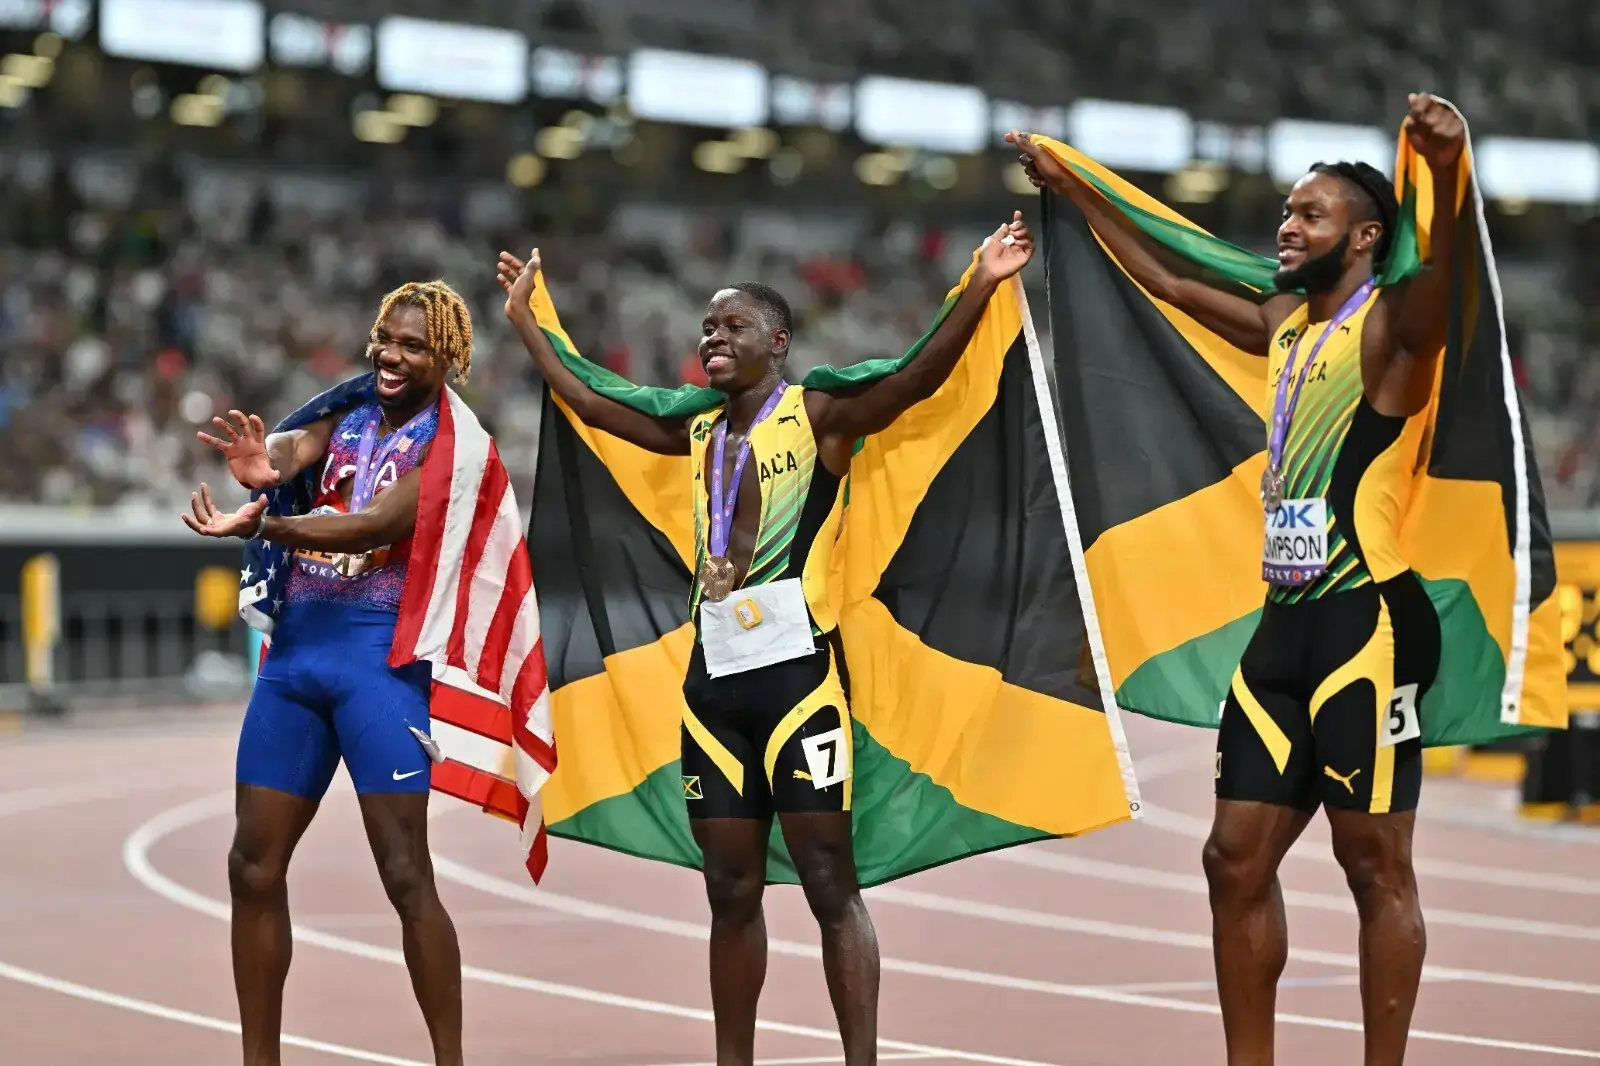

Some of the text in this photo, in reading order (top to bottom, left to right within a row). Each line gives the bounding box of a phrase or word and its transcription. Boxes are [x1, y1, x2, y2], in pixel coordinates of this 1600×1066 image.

[1266, 503, 1317, 529] DK
[301, 562, 346, 580] TOKY
[1389, 696, 1405, 736] 5
[816, 739, 837, 779] 7
